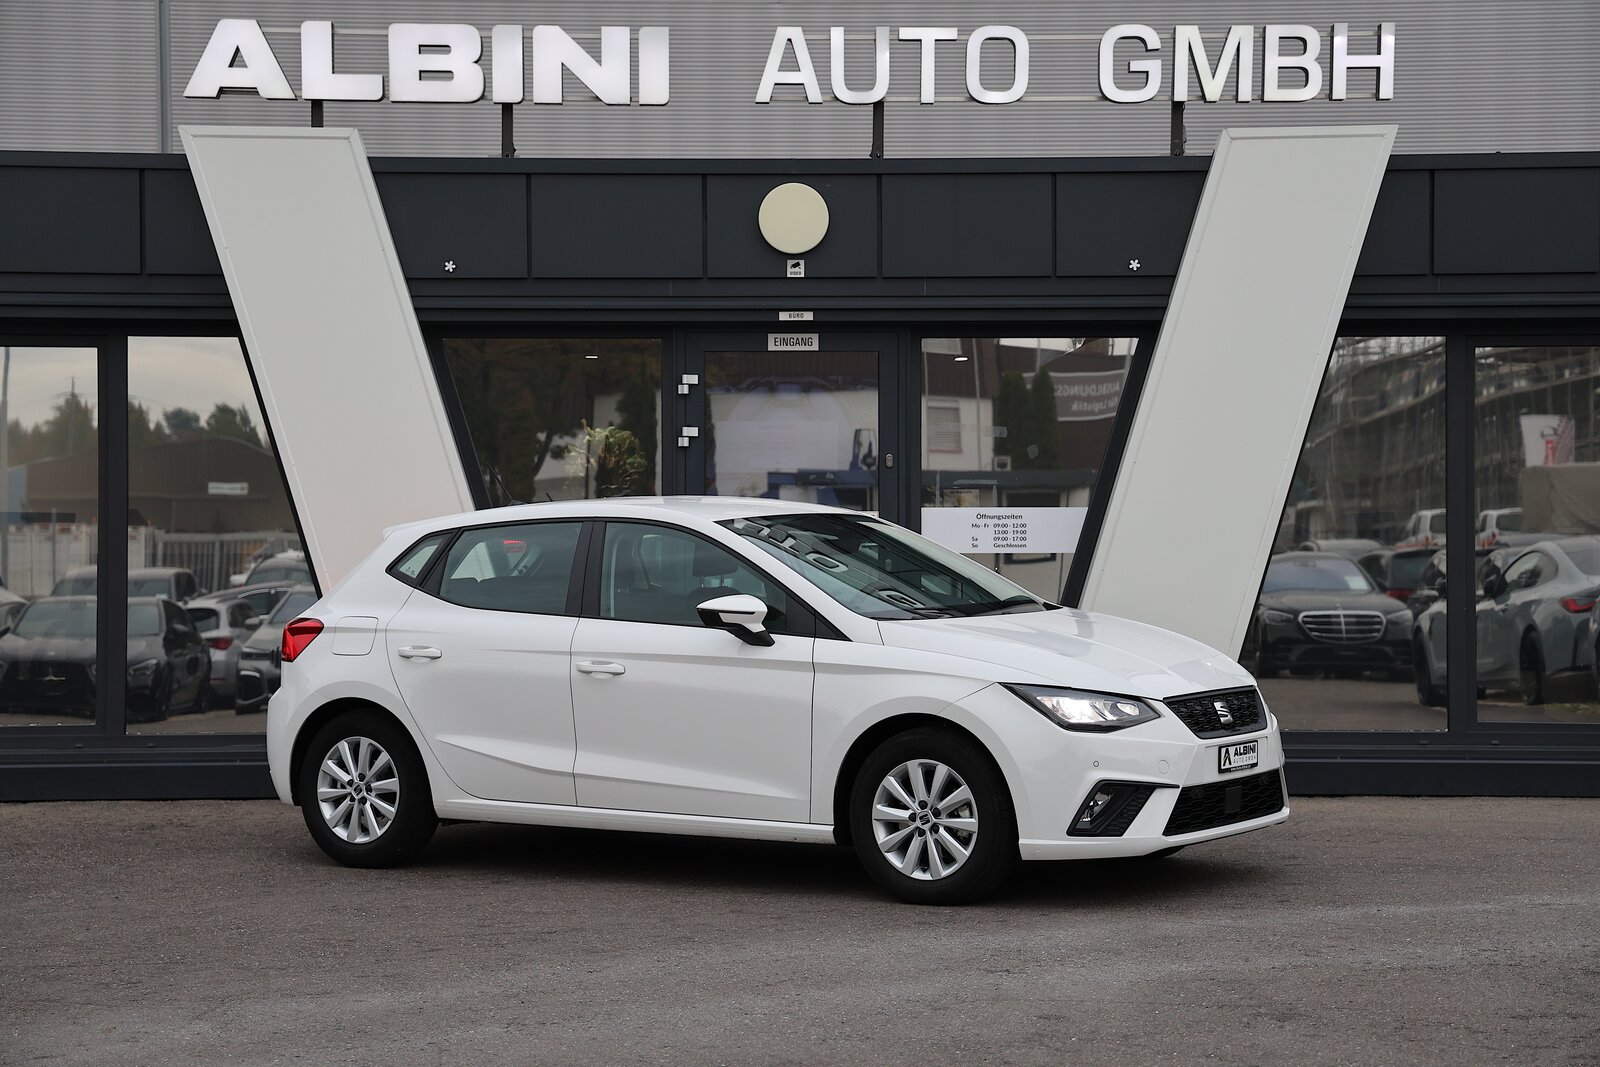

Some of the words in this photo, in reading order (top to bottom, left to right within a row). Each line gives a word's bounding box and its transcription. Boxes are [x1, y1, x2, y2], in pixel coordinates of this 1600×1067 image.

[183, 18, 670, 106] ALBINI
[755, 24, 1030, 105] AUTO
[1097, 22, 1396, 104] GMBH
[773, 337, 814, 347] EINGANG
[976, 513, 1023, 521] Öffnungszeiten
[1233, 744, 1256, 757] ALBINI
